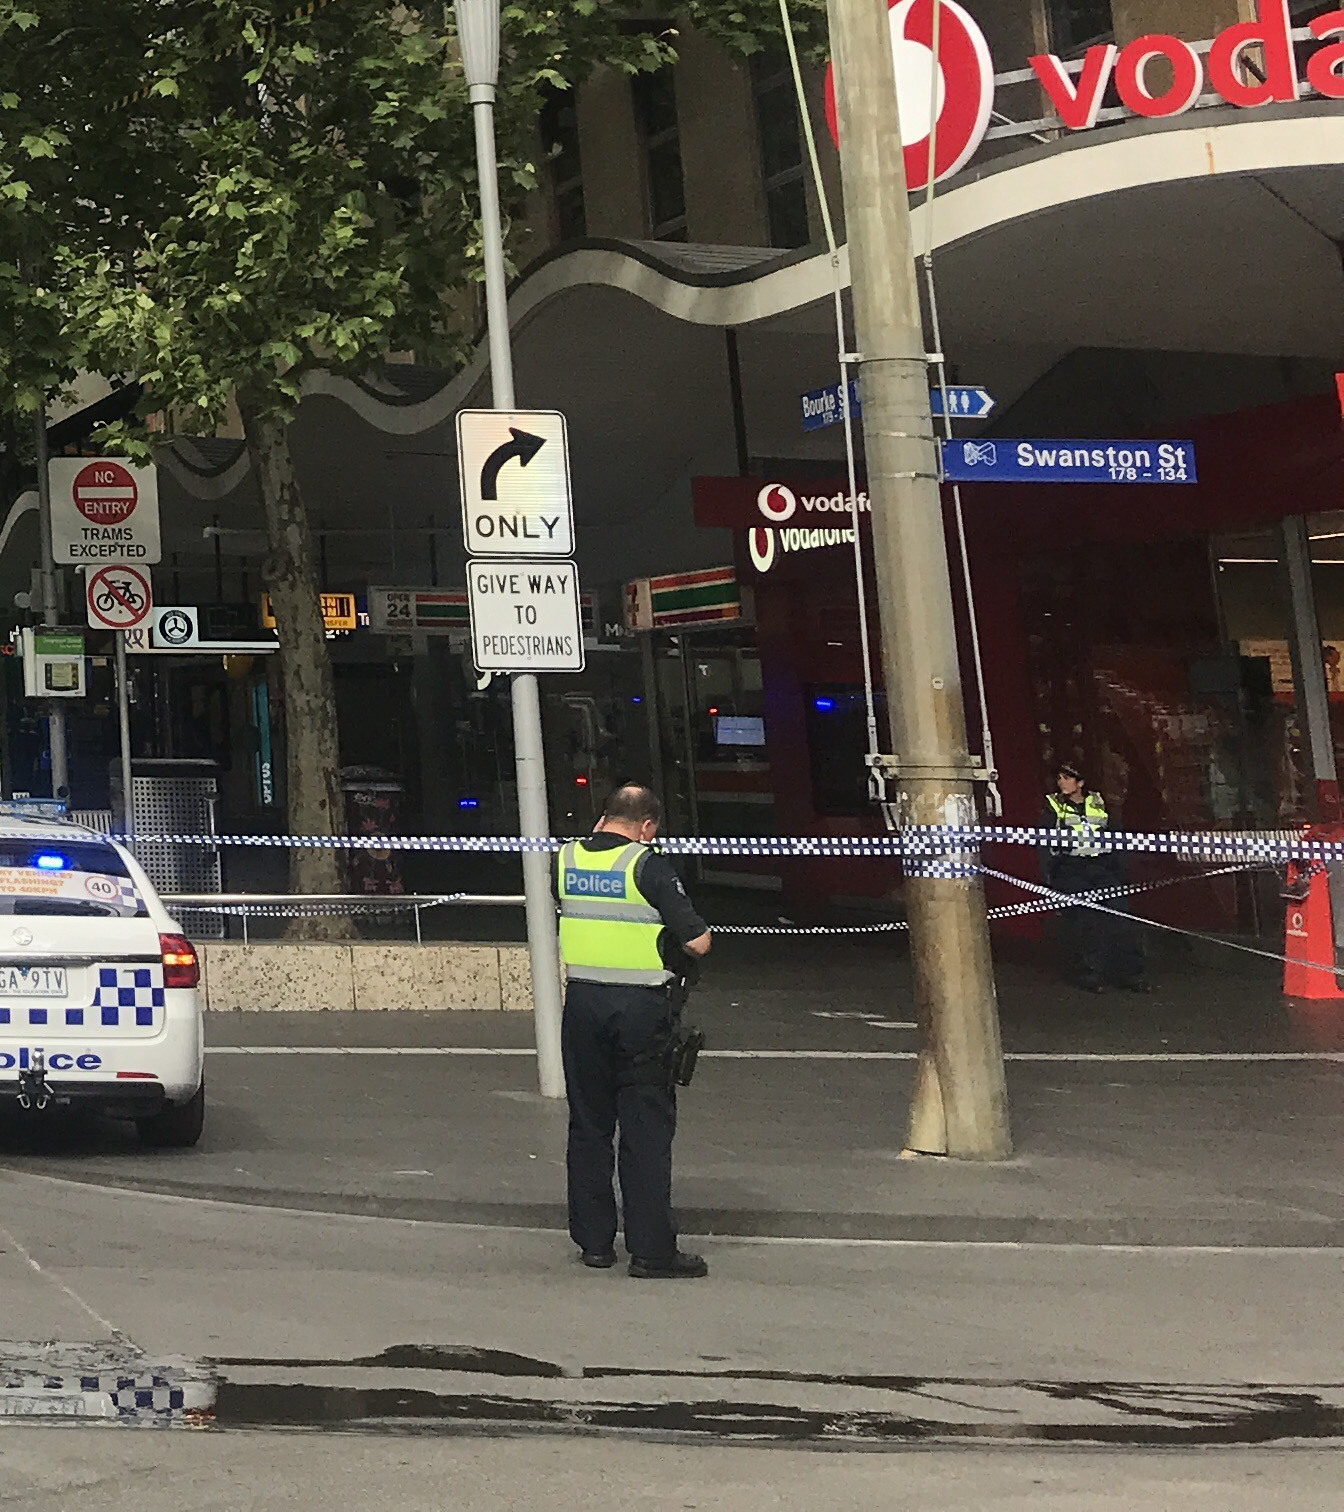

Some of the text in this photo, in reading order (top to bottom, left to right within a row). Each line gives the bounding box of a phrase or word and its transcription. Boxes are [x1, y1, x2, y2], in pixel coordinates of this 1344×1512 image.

[802, 390, 836, 419] Bourke
[1016, 442, 1187, 468] Swanston St
[94, 470, 115, 484] NO
[1108, 468, 1137, 481] 178
[1156, 468, 1187, 481] 134
[83, 501, 130, 515] ENTRY
[80, 527, 134, 541] TRAMS
[475, 514, 561, 539] ONLY
[69, 544, 147, 558] EXCEPTED
[477, 574, 569, 595] GIVE WAY
[386, 603, 411, 618] 24
[513, 604, 538, 625] TO
[482, 634, 574, 657] PEDESTRIANS
[91, 882, 112, 895] 40
[565, 872, 623, 894] Police
[31, 969, 63, 989] 9TV
